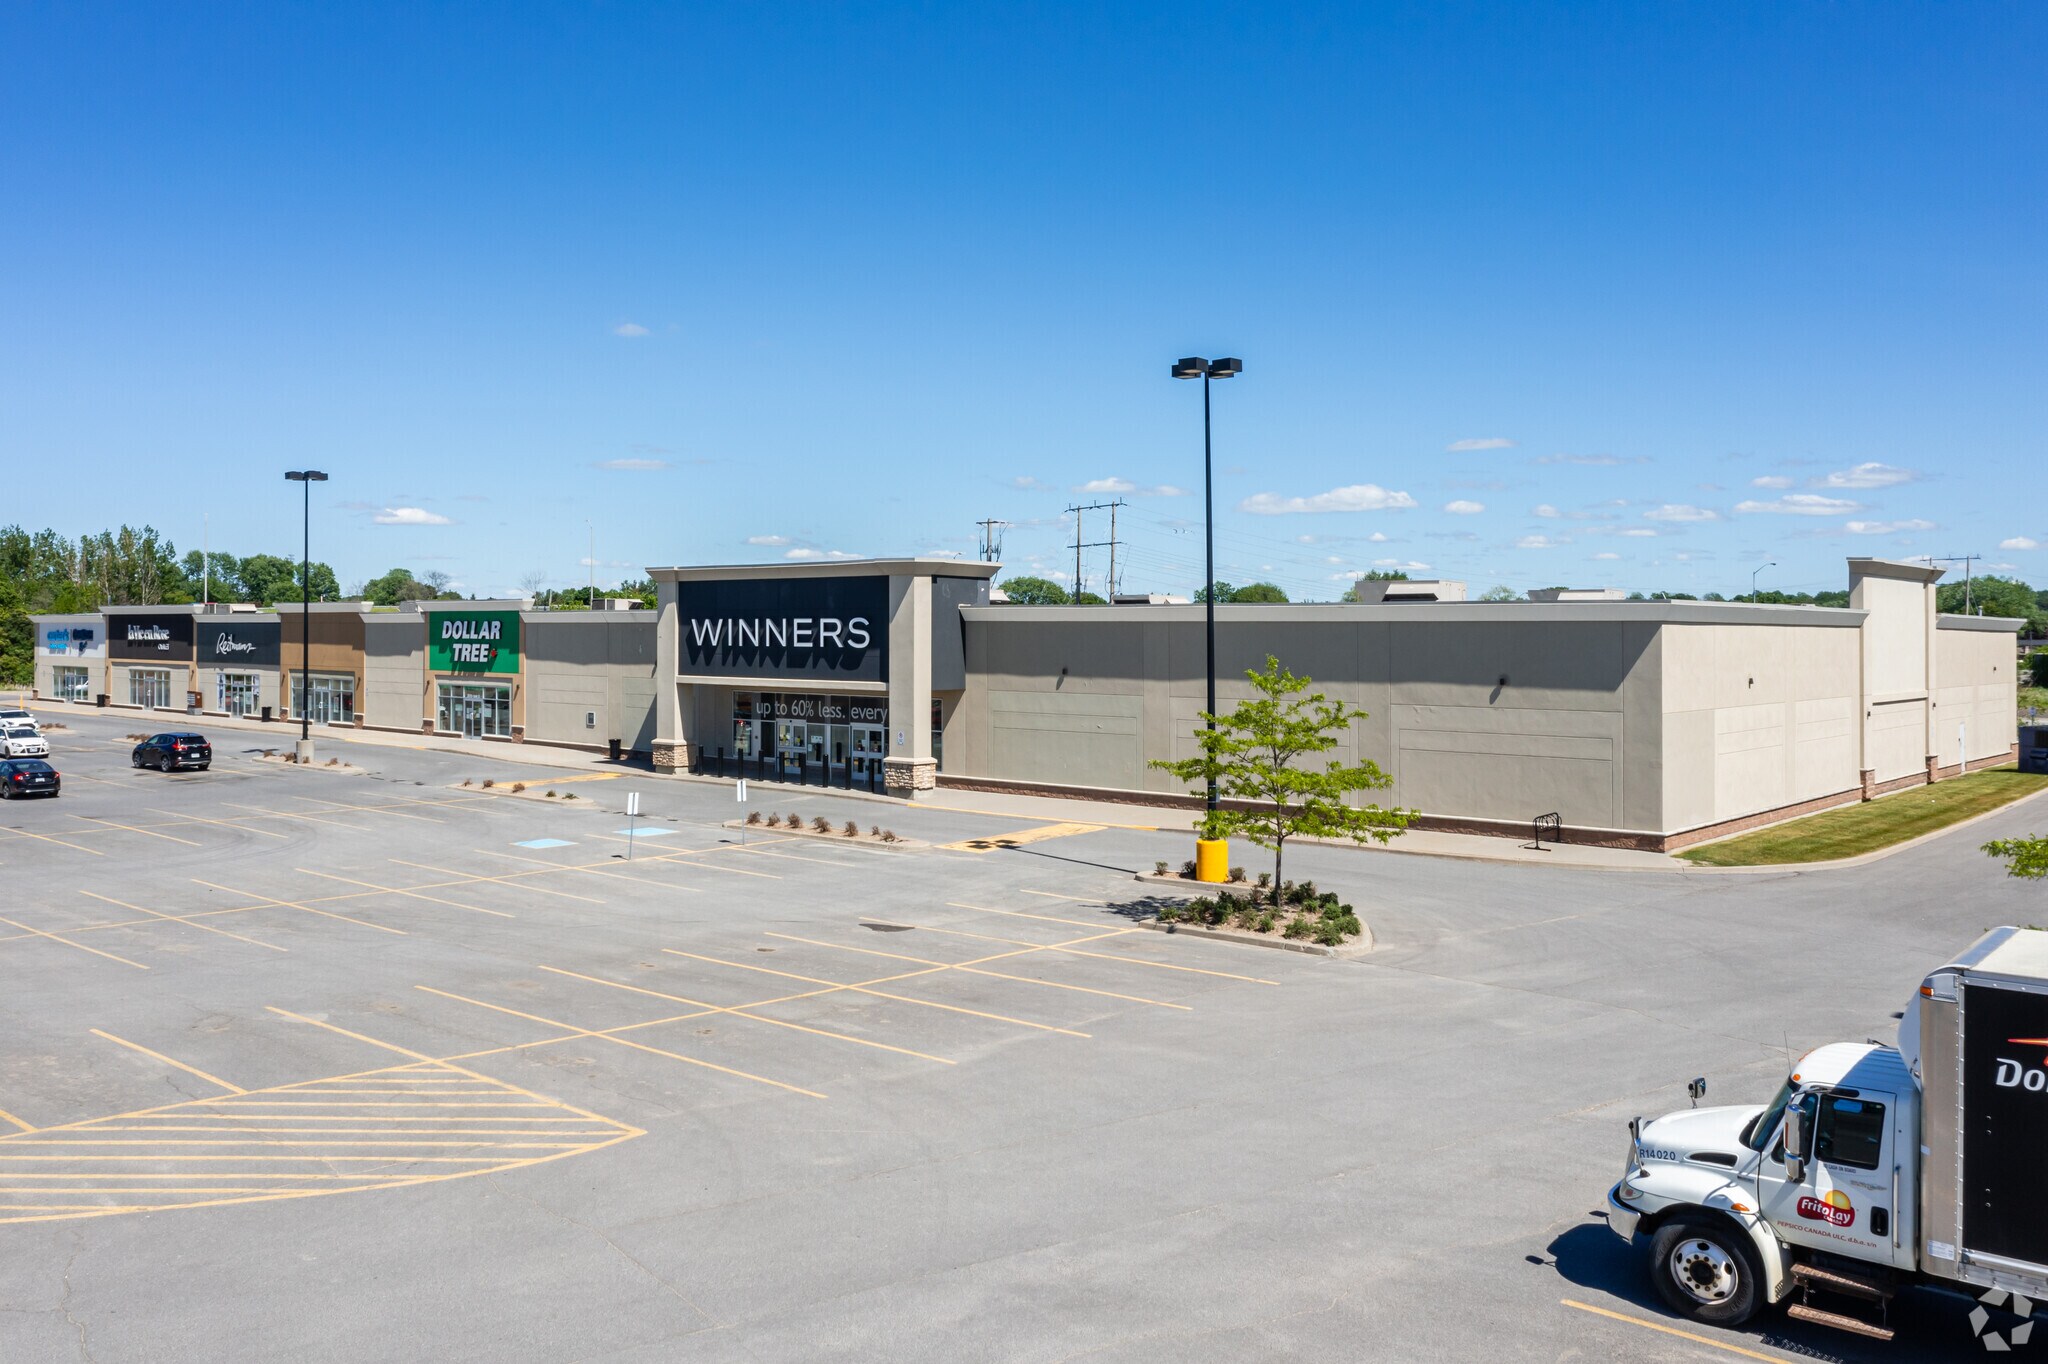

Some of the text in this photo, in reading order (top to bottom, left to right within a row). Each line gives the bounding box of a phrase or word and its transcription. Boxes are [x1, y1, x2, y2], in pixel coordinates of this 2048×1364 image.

[441, 620, 501, 640] DOLLAR
[691, 616, 871, 649] WINNERS
[452, 643, 490, 663] TREE
[756, 699, 889, 724] up to 60% less. every
[1996, 1057, 2048, 1093] Do
[1640, 1149, 1676, 1161] R14020
[1776, 1220, 1803, 1232] PEPSICO
[1803, 1225, 1832, 1238] CANADA
